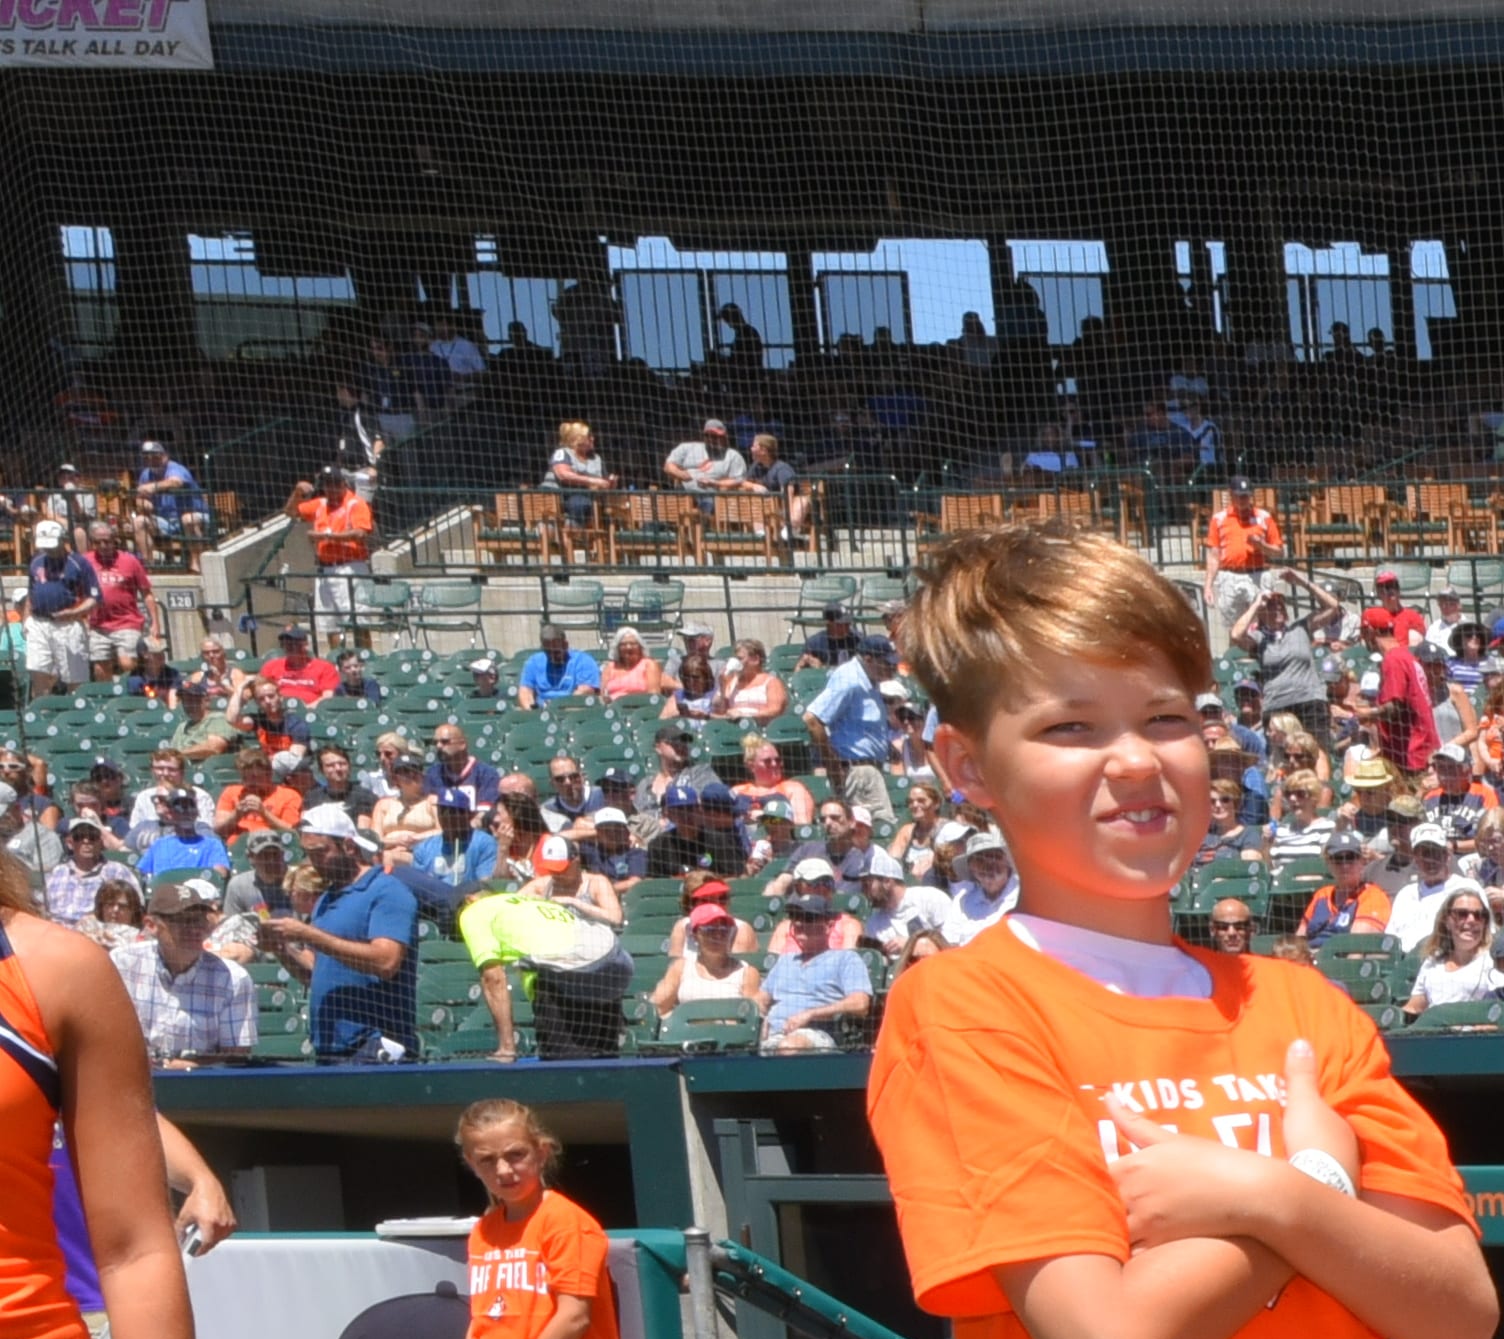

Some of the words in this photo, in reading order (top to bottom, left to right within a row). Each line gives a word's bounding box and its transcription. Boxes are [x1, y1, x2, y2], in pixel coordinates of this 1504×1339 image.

[0, 39, 15, 55] S
[22, 39, 78, 56] TALK
[84, 40, 126, 56] ALL
[133, 40, 181, 57] DAY
[1111, 1078, 1205, 1113] KIDS
